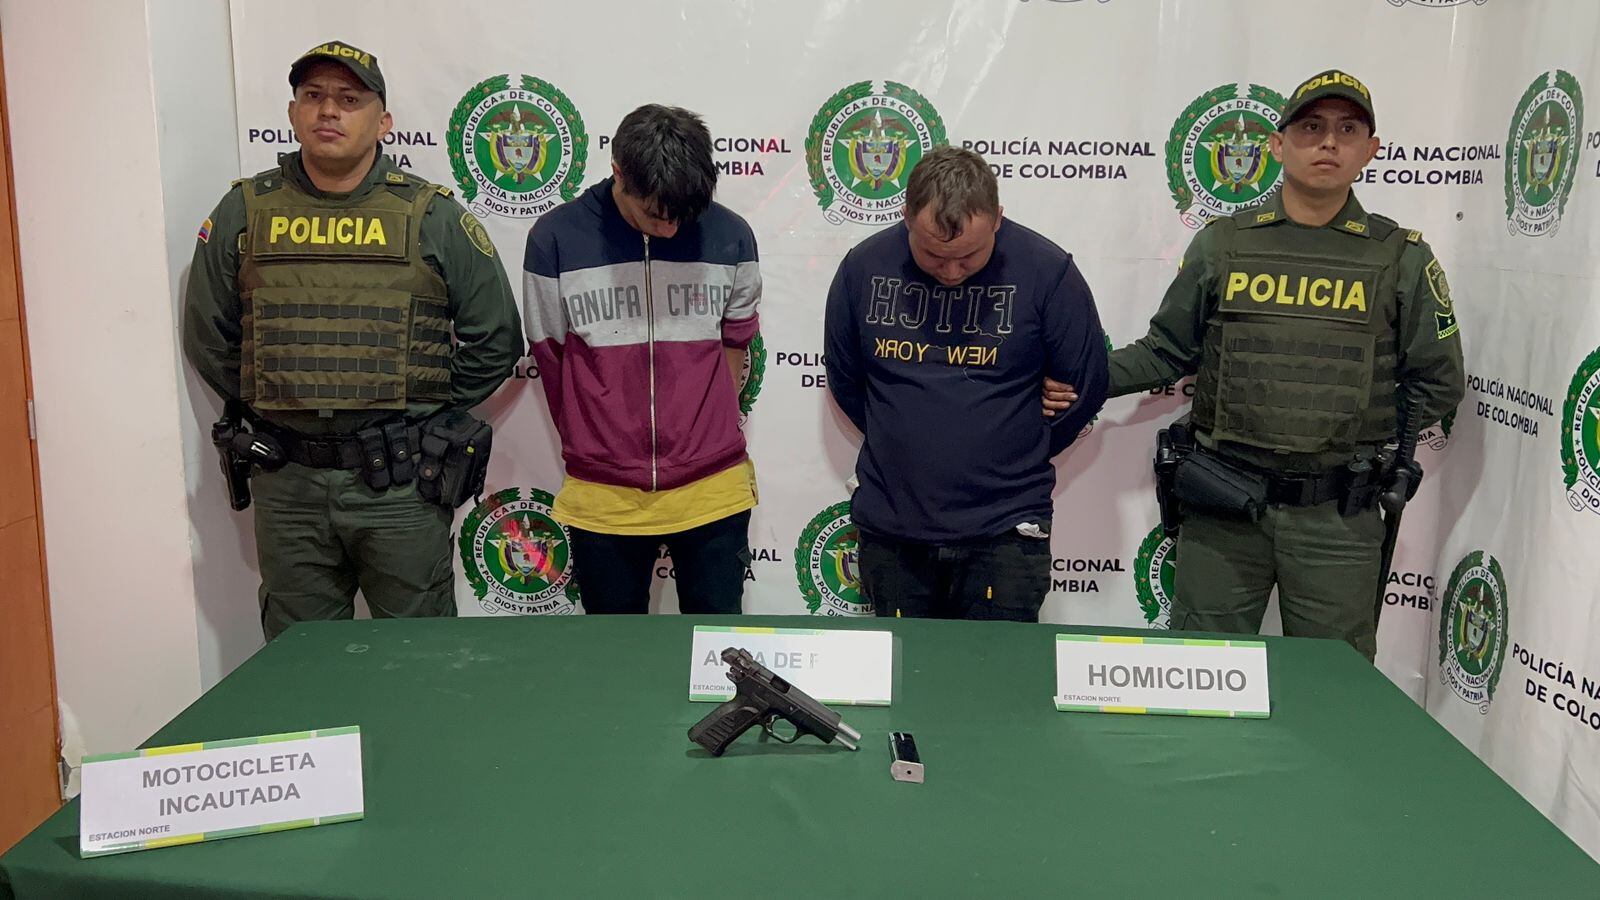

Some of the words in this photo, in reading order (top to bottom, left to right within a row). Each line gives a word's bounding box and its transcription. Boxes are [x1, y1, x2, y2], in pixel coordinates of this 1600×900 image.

[1546, 90, 1556, 100] DE
[465, 96, 499, 154] REPUBLICA
[509, 91, 525, 100] DE
[536, 98, 571, 156] COLOMBIA
[823, 102, 861, 161] REPUBLICA
[872, 97, 887, 106] DE
[898, 104, 932, 150] COLOMB
[1184, 105, 1225, 165] REPUBLICA
[1236, 100, 1251, 109] DE
[713, 137, 791, 154] CIONAL
[962, 136, 1042, 157] POLICÍA
[1048, 141, 1156, 157] NACIONAL
[1413, 144, 1501, 161] NACIONAL
[1020, 164, 1128, 180] COLOMBIA
[1383, 169, 1484, 185] COLOMBIA
[519, 169, 567, 202] NACIONAL
[484, 198, 509, 215] DIOS
[510, 206, 517, 216] Y
[520, 200, 556, 216] PATRIA
[839, 204, 865, 220] DIOS
[865, 213, 873, 222] Y
[875, 210, 905, 223] PATRI
[269, 216, 387, 246] POLICIA
[1225, 272, 1367, 312] POLICIA
[802, 375, 826, 388] DE
[1467, 374, 1504, 399] POLICÍA
[1506, 385, 1554, 417] NACIONAL
[1476, 401, 1490, 419] DE
[1491, 406, 1539, 438] COLOMBIA
[475, 507, 509, 559] REPUBLICA
[520, 502, 535, 510] DE
[811, 518, 847, 569] REPUBLICA
[1052, 558, 1125, 572] CIONAL
[1480, 569, 1490, 581] DE
[526, 571, 571, 602] NACIONAL
[1052, 579, 1099, 593] MBIA
[494, 596, 516, 612] DIOS
[526, 599, 561, 614] PATRIA
[773, 651, 803, 669] DE
[1512, 642, 1576, 690] POLICÍA
[692, 684, 726, 692] ESTACION
[1088, 664, 1247, 692] HOMICIDIO
[1063, 694, 1098, 702] ESTACION
[1098, 695, 1121, 703] NORTE
[1462, 687, 1484, 701] PATRIA
[1525, 678, 1547, 704] DE
[1552, 693, 1600, 731] COLO
[142, 752, 316, 789] MOTOCICLETA
[158, 782, 301, 817] INCAUTADA
[88, 828, 137, 842] ESTACION
[138, 824, 171, 836] NORTE
